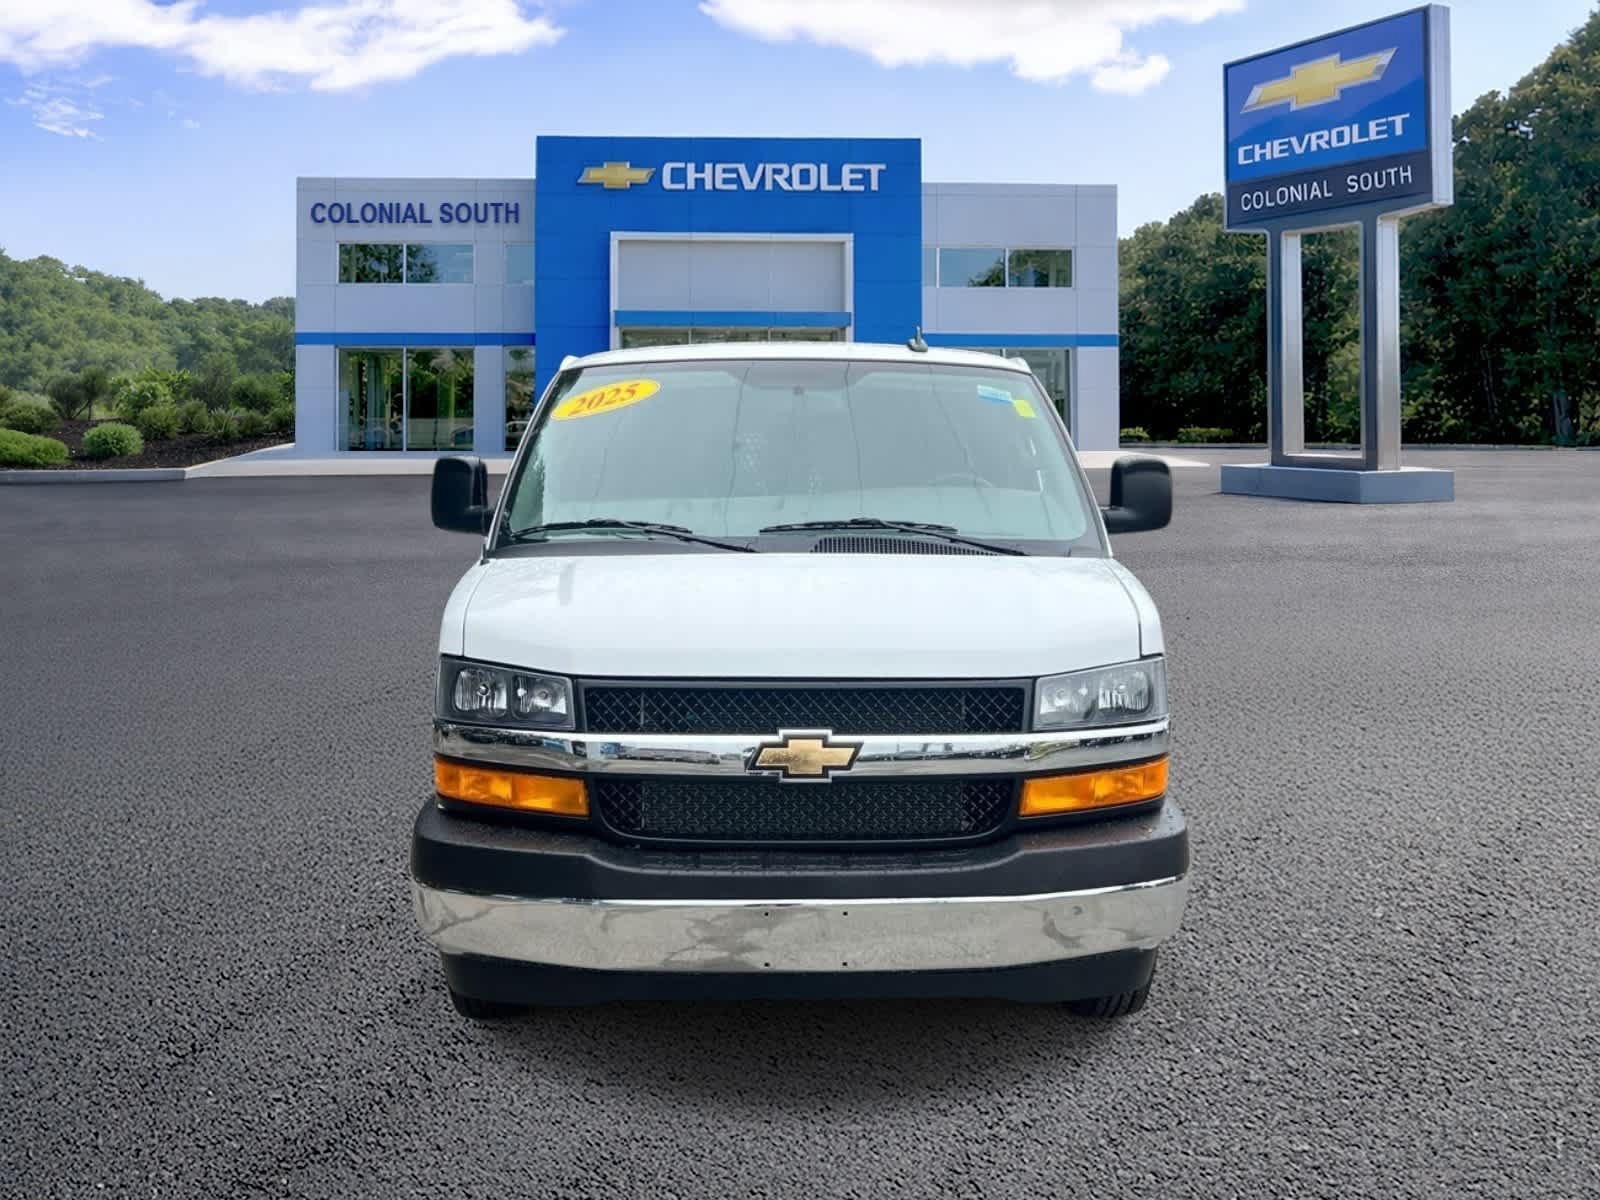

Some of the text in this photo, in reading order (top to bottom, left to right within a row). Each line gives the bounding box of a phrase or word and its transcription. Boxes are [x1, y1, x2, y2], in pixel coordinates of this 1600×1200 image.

[1237, 113, 1410, 166] CHEVROLET
[661, 161, 887, 192] CHEVROLET
[1240, 165, 1412, 211] COLONIAL SOUTH
[310, 202, 520, 225] COLONIAL SOUTH
[567, 383, 640, 417] 2025
